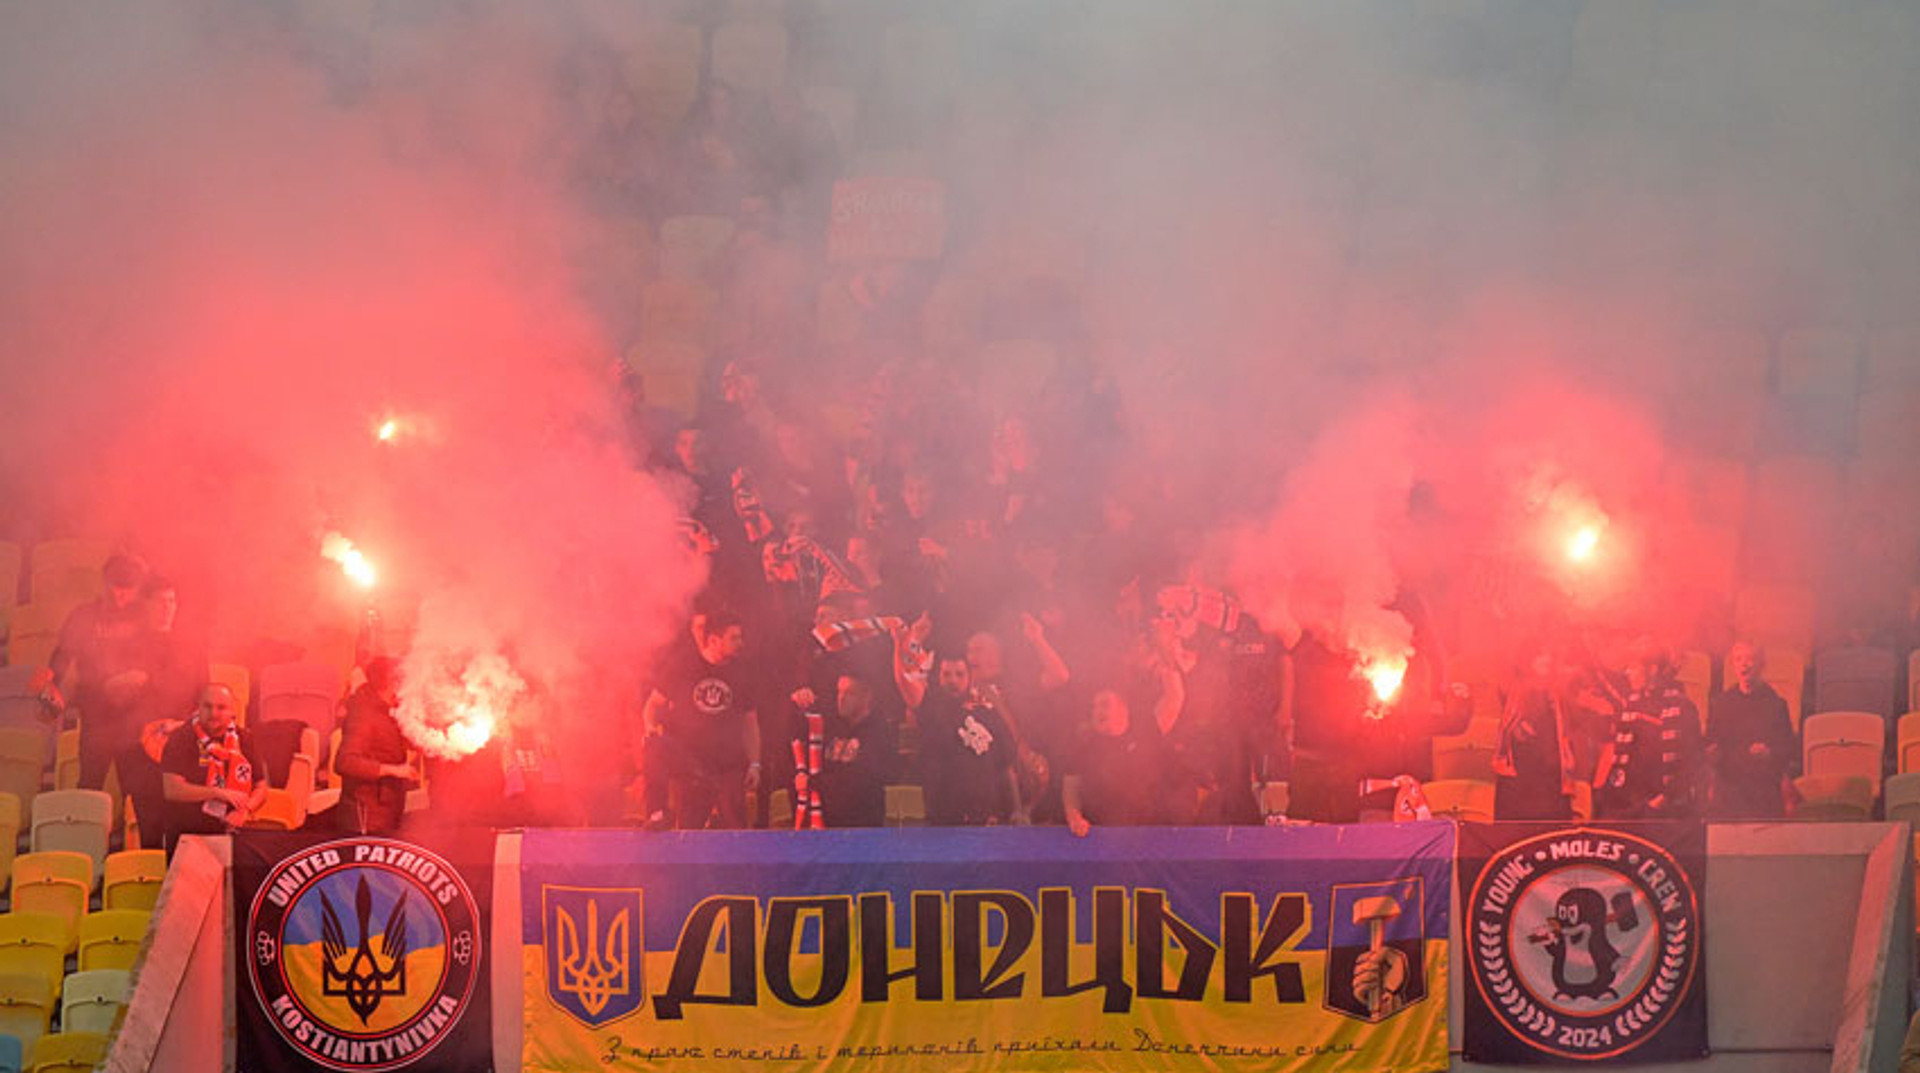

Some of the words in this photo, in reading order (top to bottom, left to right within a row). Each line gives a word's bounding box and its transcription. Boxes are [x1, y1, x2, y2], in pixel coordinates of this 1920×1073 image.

[267, 848, 342, 908] UNITED
[354, 845, 459, 905] PATRIOTS
[1483, 855, 1534, 912] YOUNG
[1549, 839, 1627, 860] MOLES
[1638, 859, 1682, 911] CREW
[653, 886, 1312, 1020] ДОНЕЦЬК
[271, 993, 459, 1063] KOSTIANTYNIVKA
[1558, 1025, 1614, 1048] 2024
